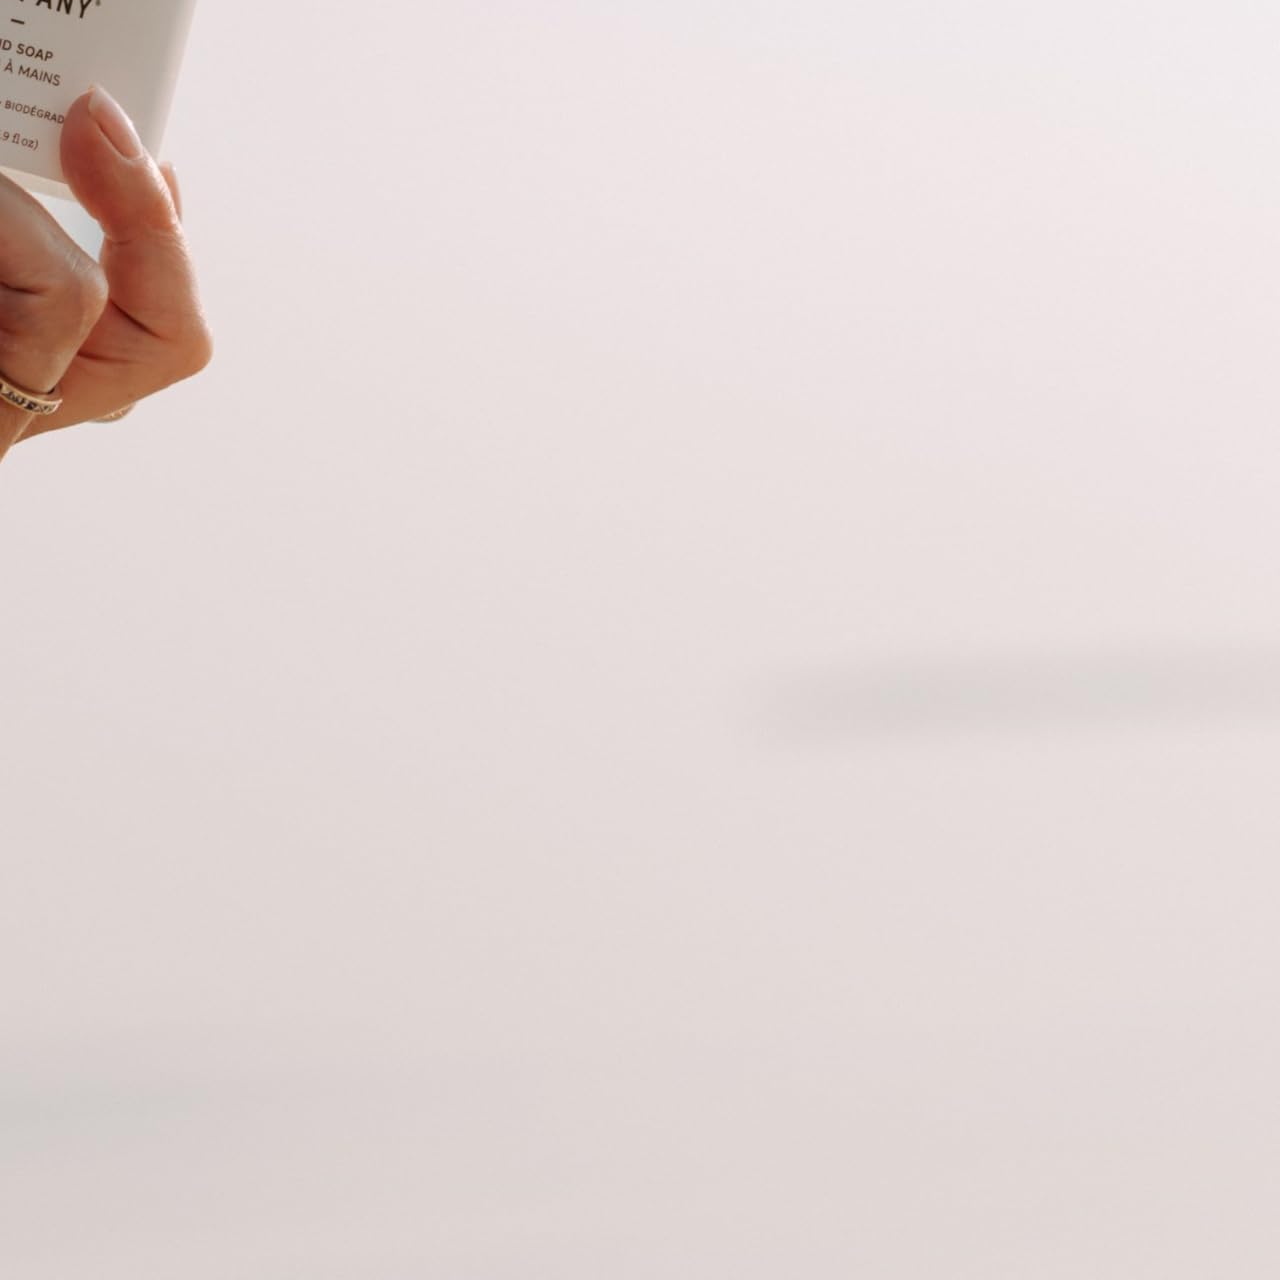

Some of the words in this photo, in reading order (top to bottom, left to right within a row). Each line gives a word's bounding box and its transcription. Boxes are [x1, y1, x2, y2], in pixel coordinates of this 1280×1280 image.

[16, 43, 54, 62] SOAP
[3, 58, 14, 74] À
[17, 65, 61, 87] MAINS
